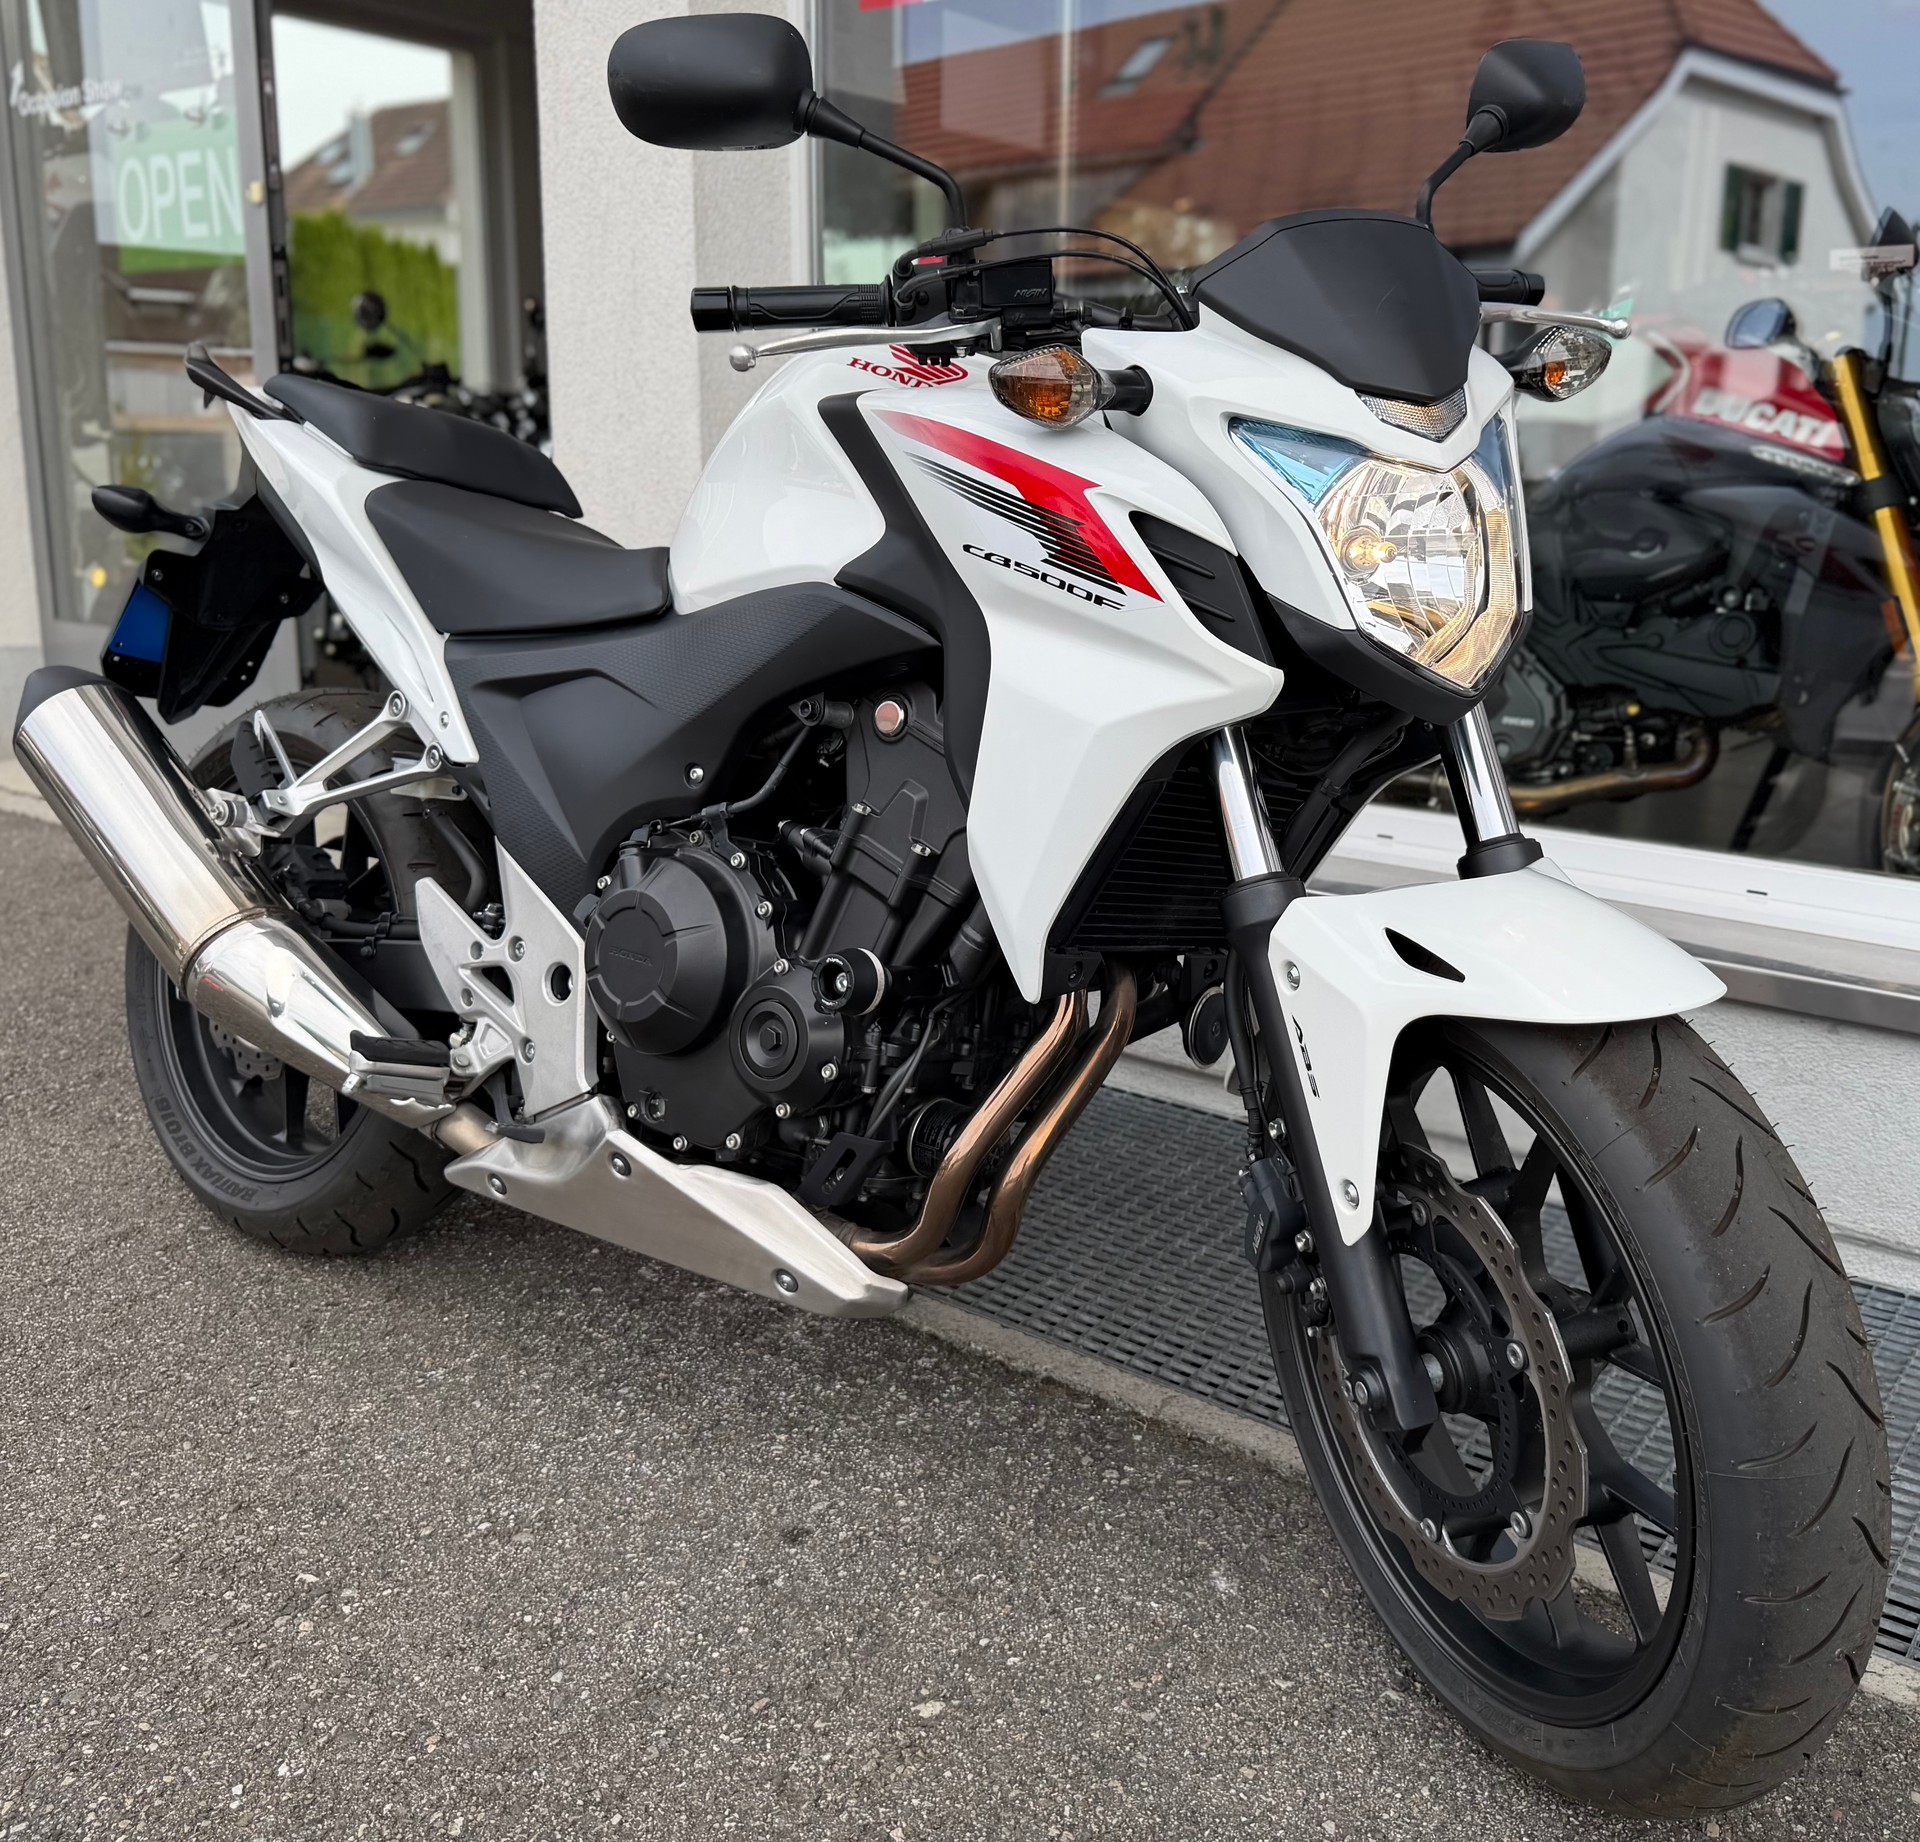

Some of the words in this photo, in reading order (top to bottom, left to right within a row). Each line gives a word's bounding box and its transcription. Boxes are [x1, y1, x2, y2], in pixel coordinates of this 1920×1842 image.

[118, 147, 244, 244] OPEN
[847, 356, 934, 388] HOND
[1691, 387, 1832, 447] DUCATI
[962, 543, 1126, 611] CB500F
[1291, 1014, 1321, 1099] ABS
